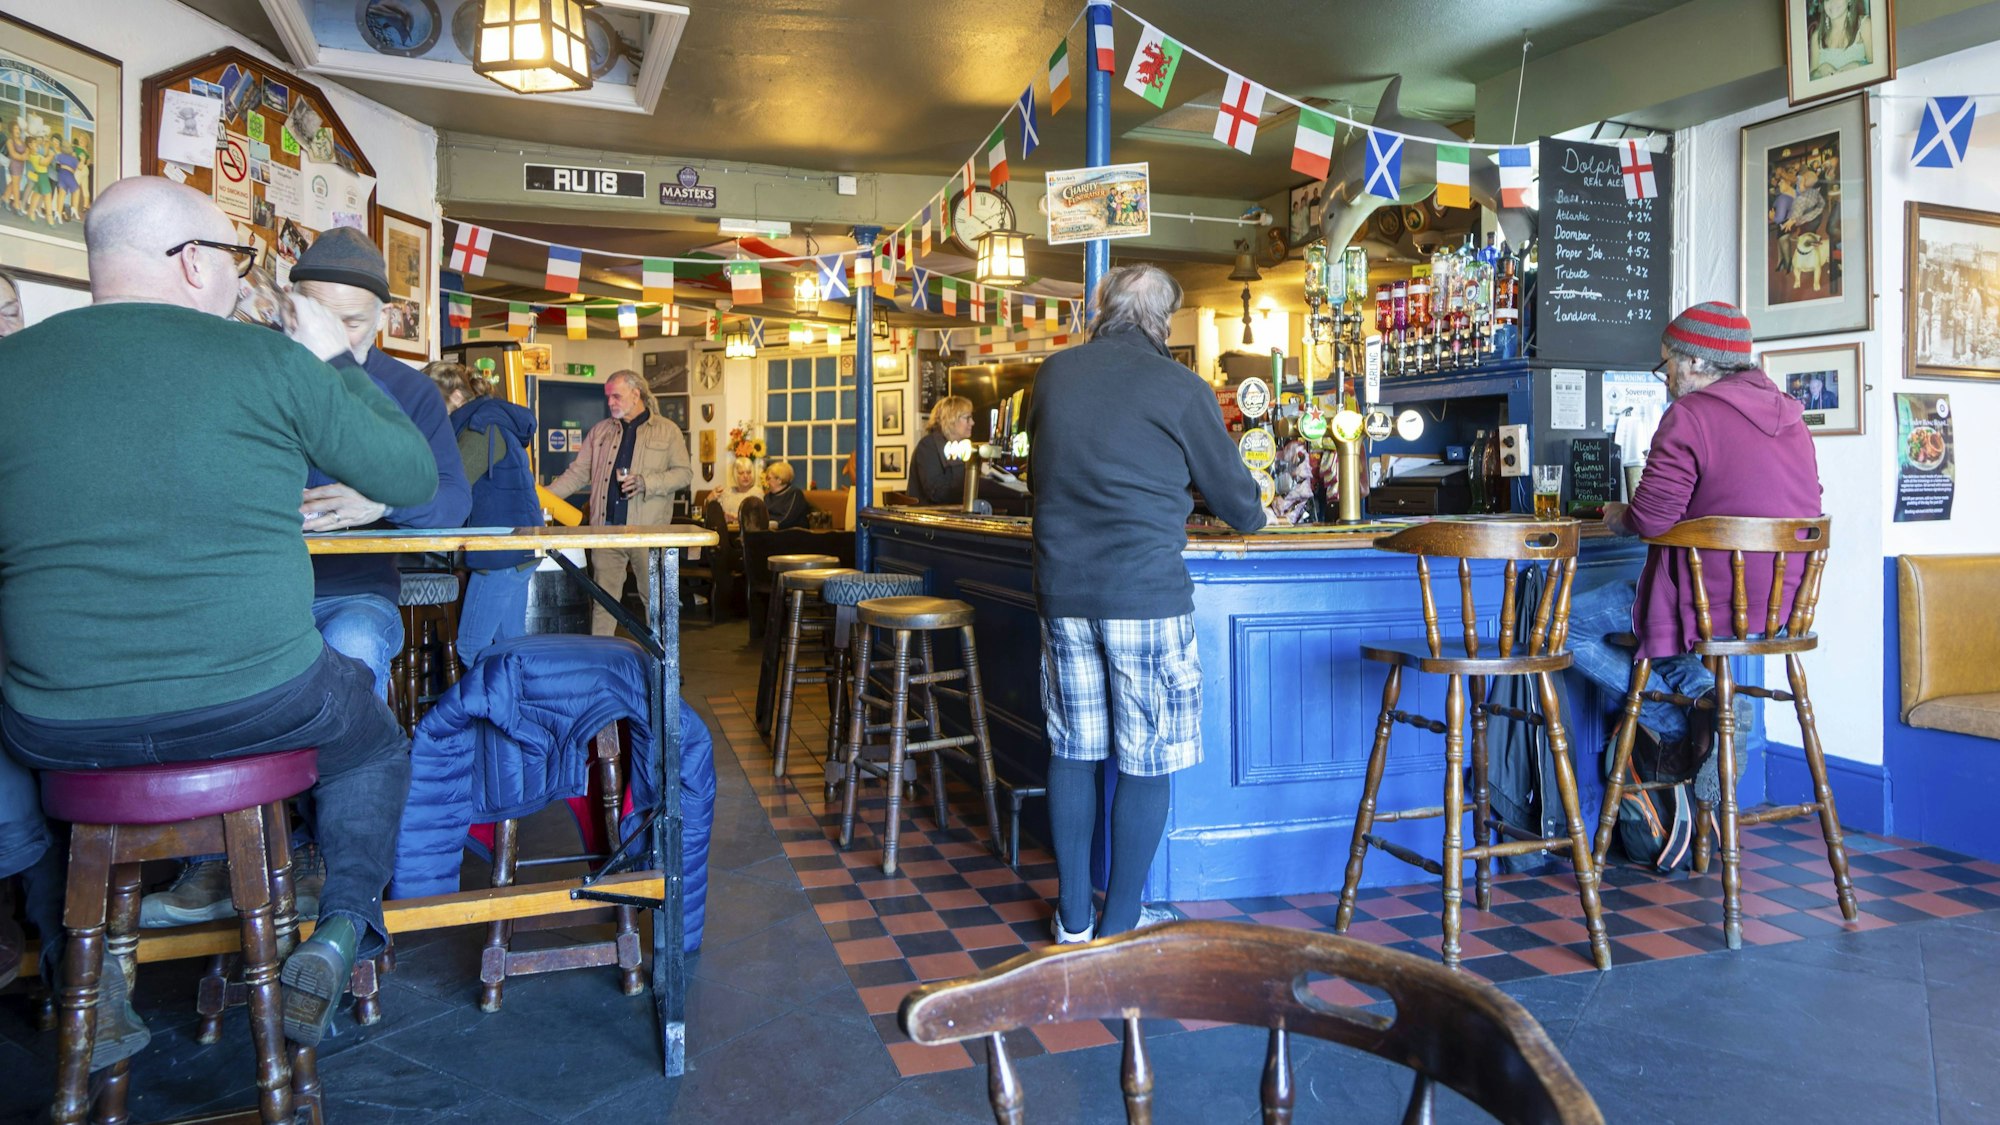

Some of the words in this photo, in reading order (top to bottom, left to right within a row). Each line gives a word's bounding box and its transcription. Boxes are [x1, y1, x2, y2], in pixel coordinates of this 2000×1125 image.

[1562, 147, 1622, 177] Dolphi
[554, 168, 588, 192] RU
[1583, 176, 1603, 187] REAL
[1607, 177, 1625, 188] ALES
[662, 187, 715, 200] MASTERS
[1063, 182, 1098, 200] CHARITY
[1068, 190, 1105, 206] FUNDRAISER
[1556, 189, 1579, 204] Bass
[1556, 208, 1590, 222] Atlantic
[1554, 224, 1591, 241] Doombar
[1556, 243, 1583, 260] Proper
[1587, 243, 1603, 261] Job
[1555, 264, 1590, 280] Tribute
[1554, 305, 1597, 322] Landlord
[1369, 352, 1379, 387] CARLING
[1614, 373, 1646, 382] WARNING
[1625, 387, 1656, 397] Sovereign
[1574, 440, 1601, 451] Alcohol
